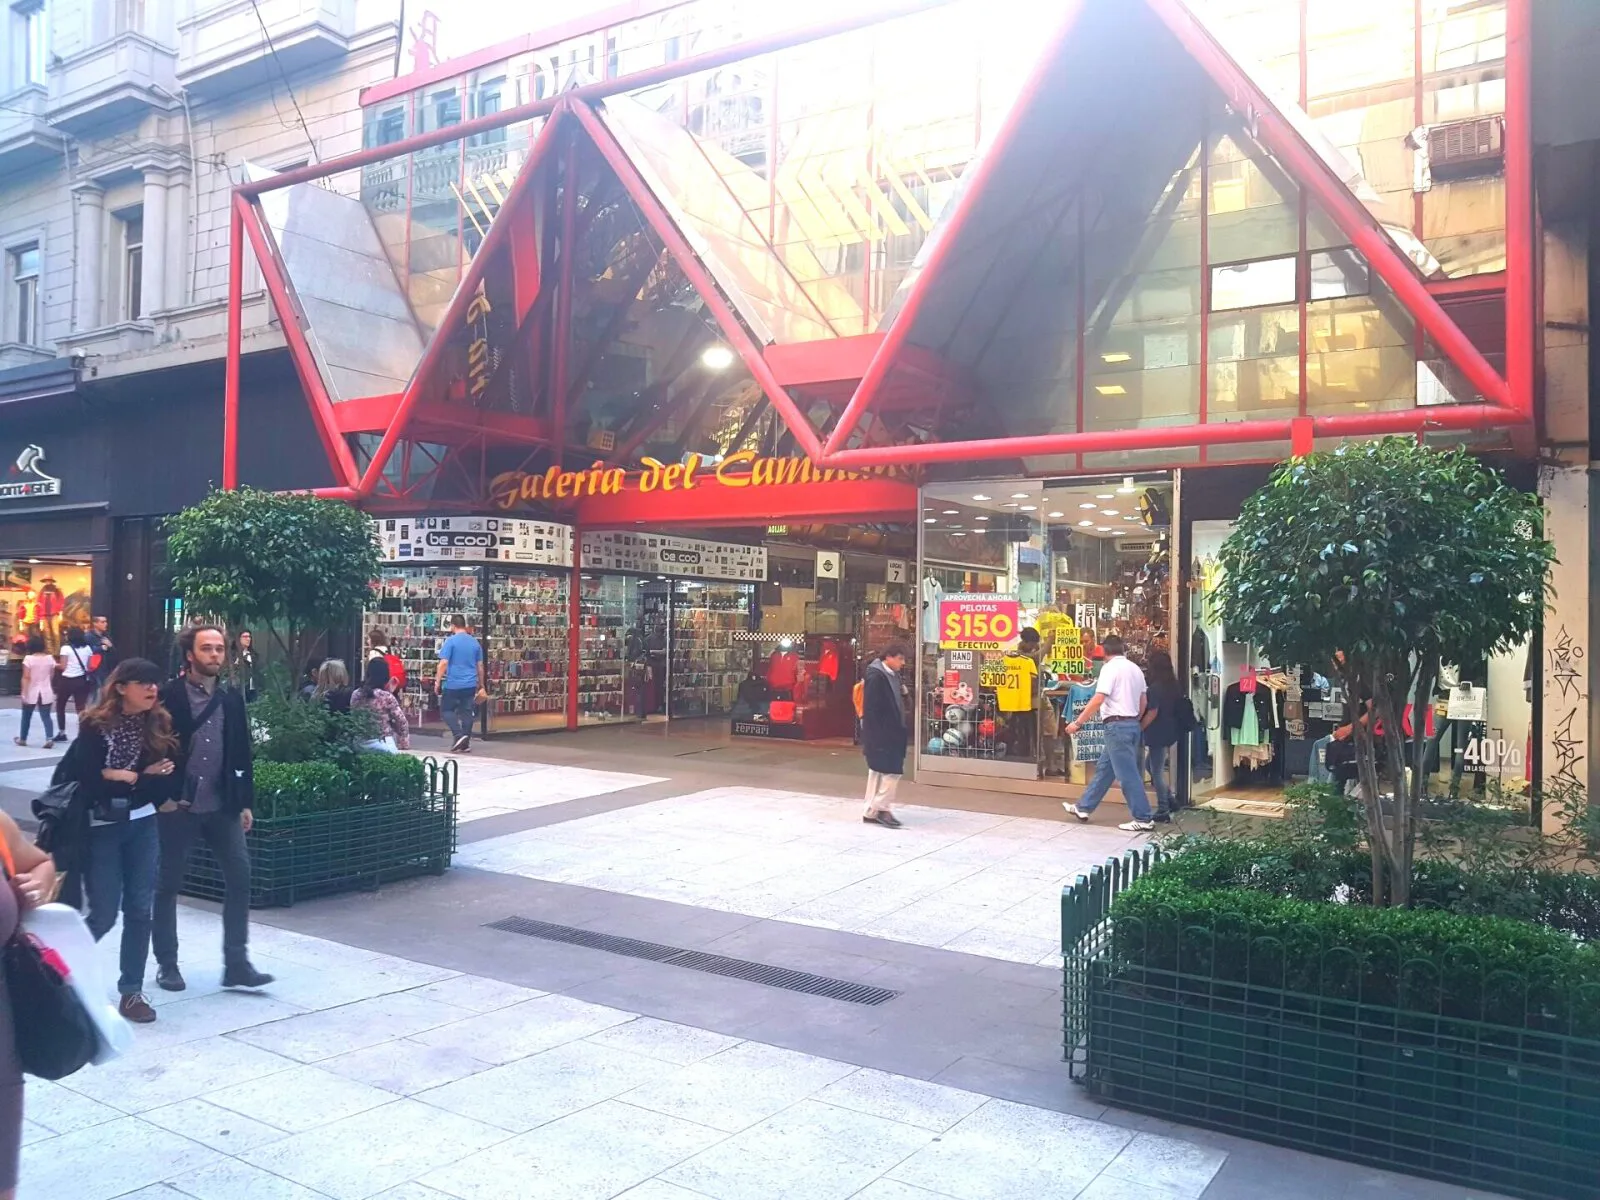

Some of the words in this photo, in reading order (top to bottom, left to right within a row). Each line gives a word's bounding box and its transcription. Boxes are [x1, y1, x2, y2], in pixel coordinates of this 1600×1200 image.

[639, 452, 701, 493] del
[429, 534, 449, 546] be
[453, 535, 492, 547] cool
[663, 551, 676, 561] be
[679, 553, 699, 563] cool
[894, 570, 900, 581] 7
[960, 604, 998, 612] PELOTAS
[944, 611, 1013, 640] $150
[1057, 628, 1079, 636] SHORT
[957, 641, 999, 649] EFECTIVO
[1057, 637, 1078, 645] PROMO
[952, 652, 971, 661] HAND
[1007, 673, 1020, 690] 21
[735, 722, 769, 735] Ferrari
[1454, 738, 1521, 766] -40%
